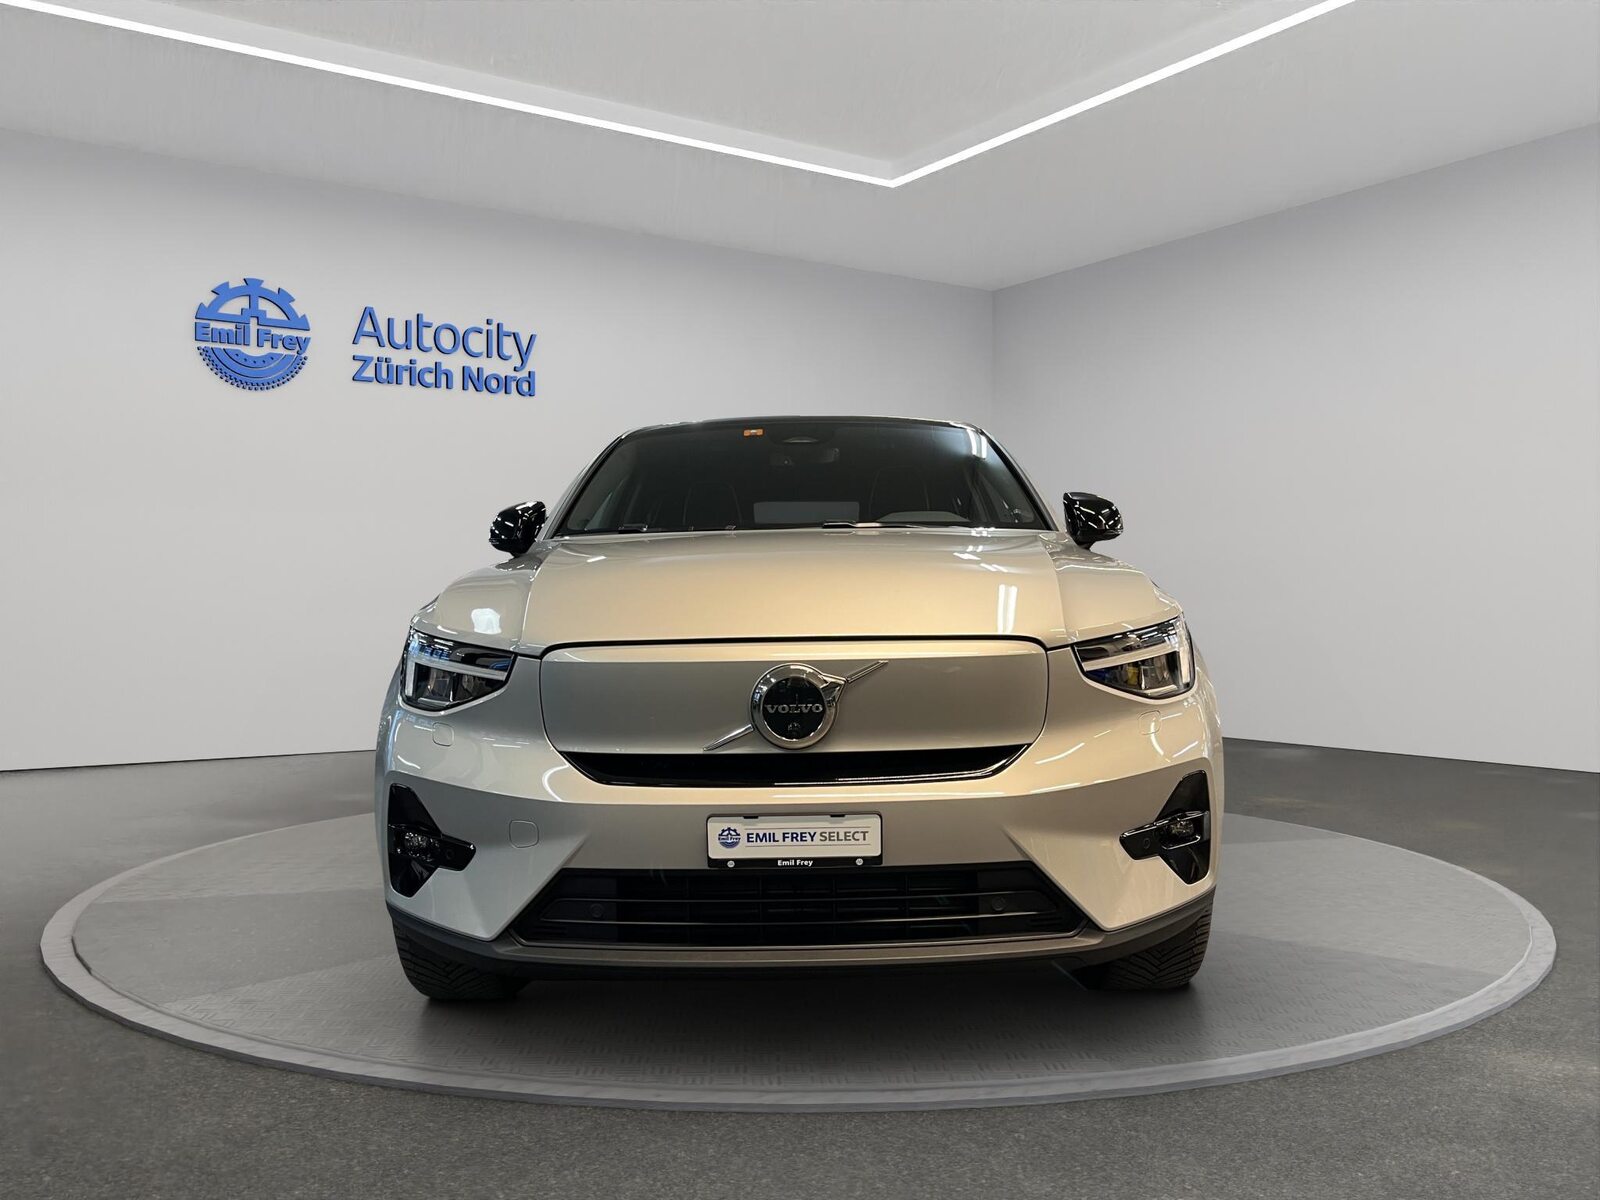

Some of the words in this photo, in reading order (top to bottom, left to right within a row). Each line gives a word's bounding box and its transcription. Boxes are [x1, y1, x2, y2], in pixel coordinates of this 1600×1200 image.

[195, 321, 250, 346] Emil
[256, 328, 311, 355] Frey
[353, 306, 536, 371] Autocity
[352, 354, 453, 389] Zürich
[462, 366, 536, 397] Nord
[764, 703, 823, 713] VOLVO
[746, 832, 779, 843] EMIL
[782, 831, 816, 842] FREY
[819, 830, 869, 842] SELECT
[797, 859, 813, 867] Frey
